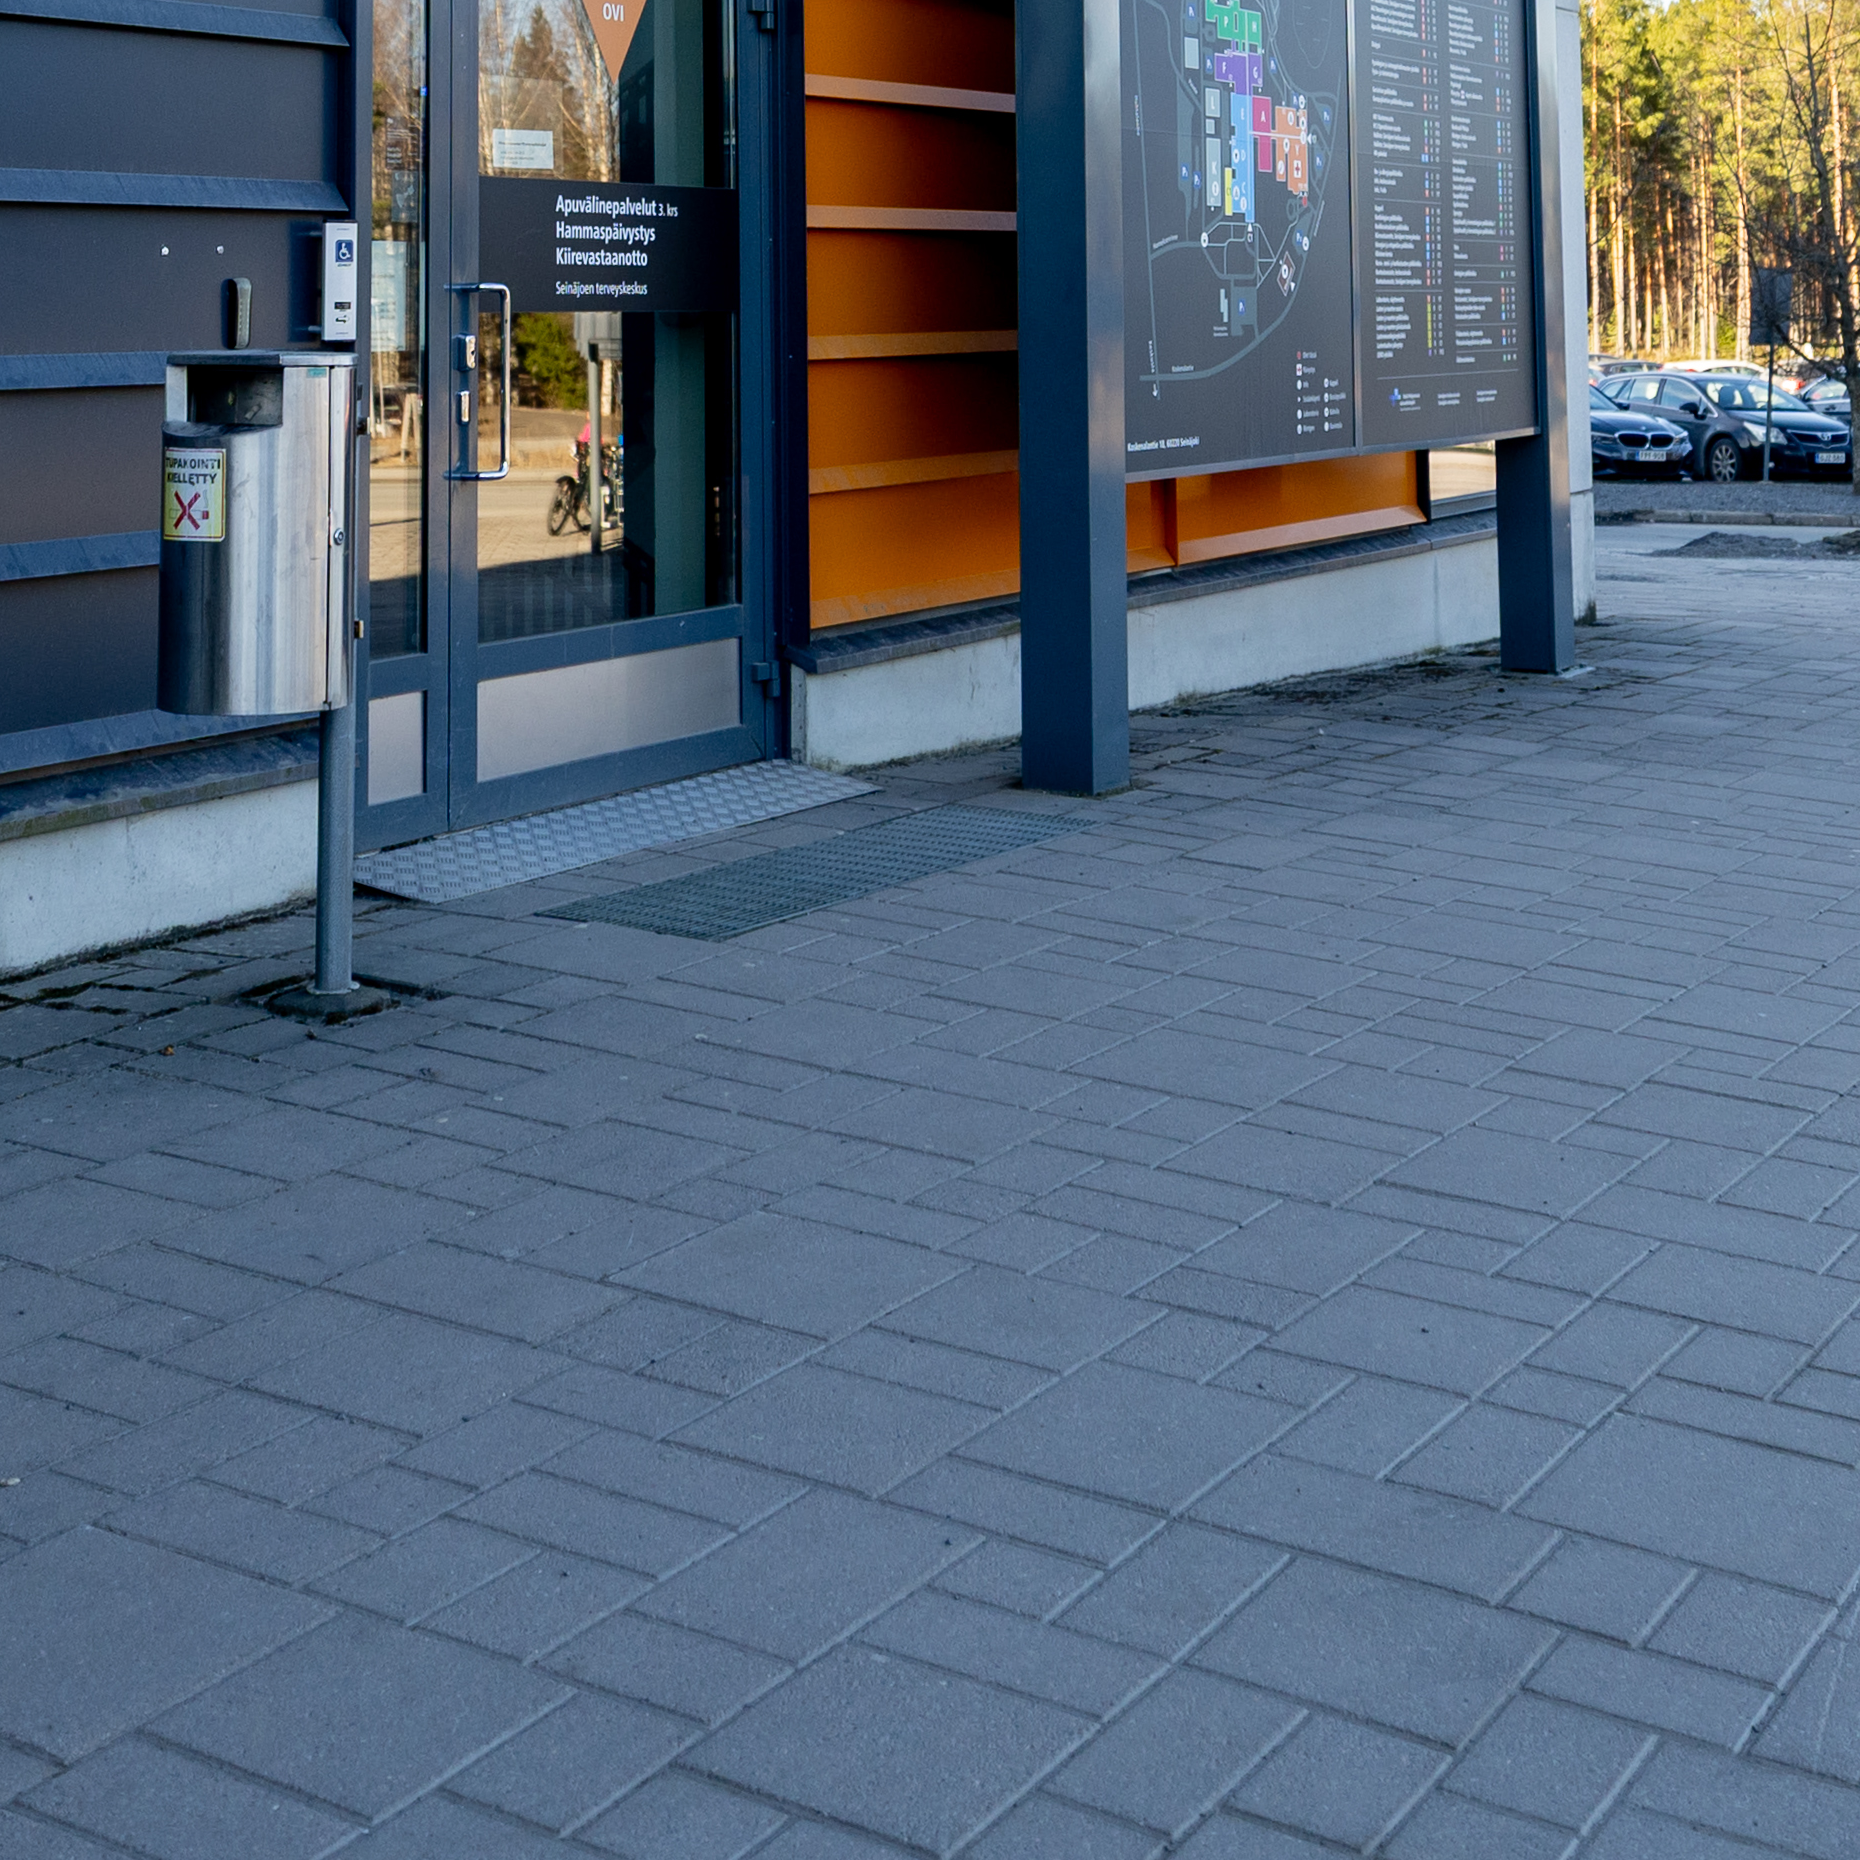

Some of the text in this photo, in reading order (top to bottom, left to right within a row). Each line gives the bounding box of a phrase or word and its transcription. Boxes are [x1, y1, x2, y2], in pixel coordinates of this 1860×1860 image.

[602, 2, 625, 23] OVI
[555, 194, 657, 218] Apuvälinepalvelut
[555, 221, 656, 245] Hammaspäivystys
[555, 247, 648, 266] Kiirevastaanotto
[555, 281, 648, 298] Seinäjoen terveyskeskus
[165, 457, 221, 470] TUPAKOINTI
